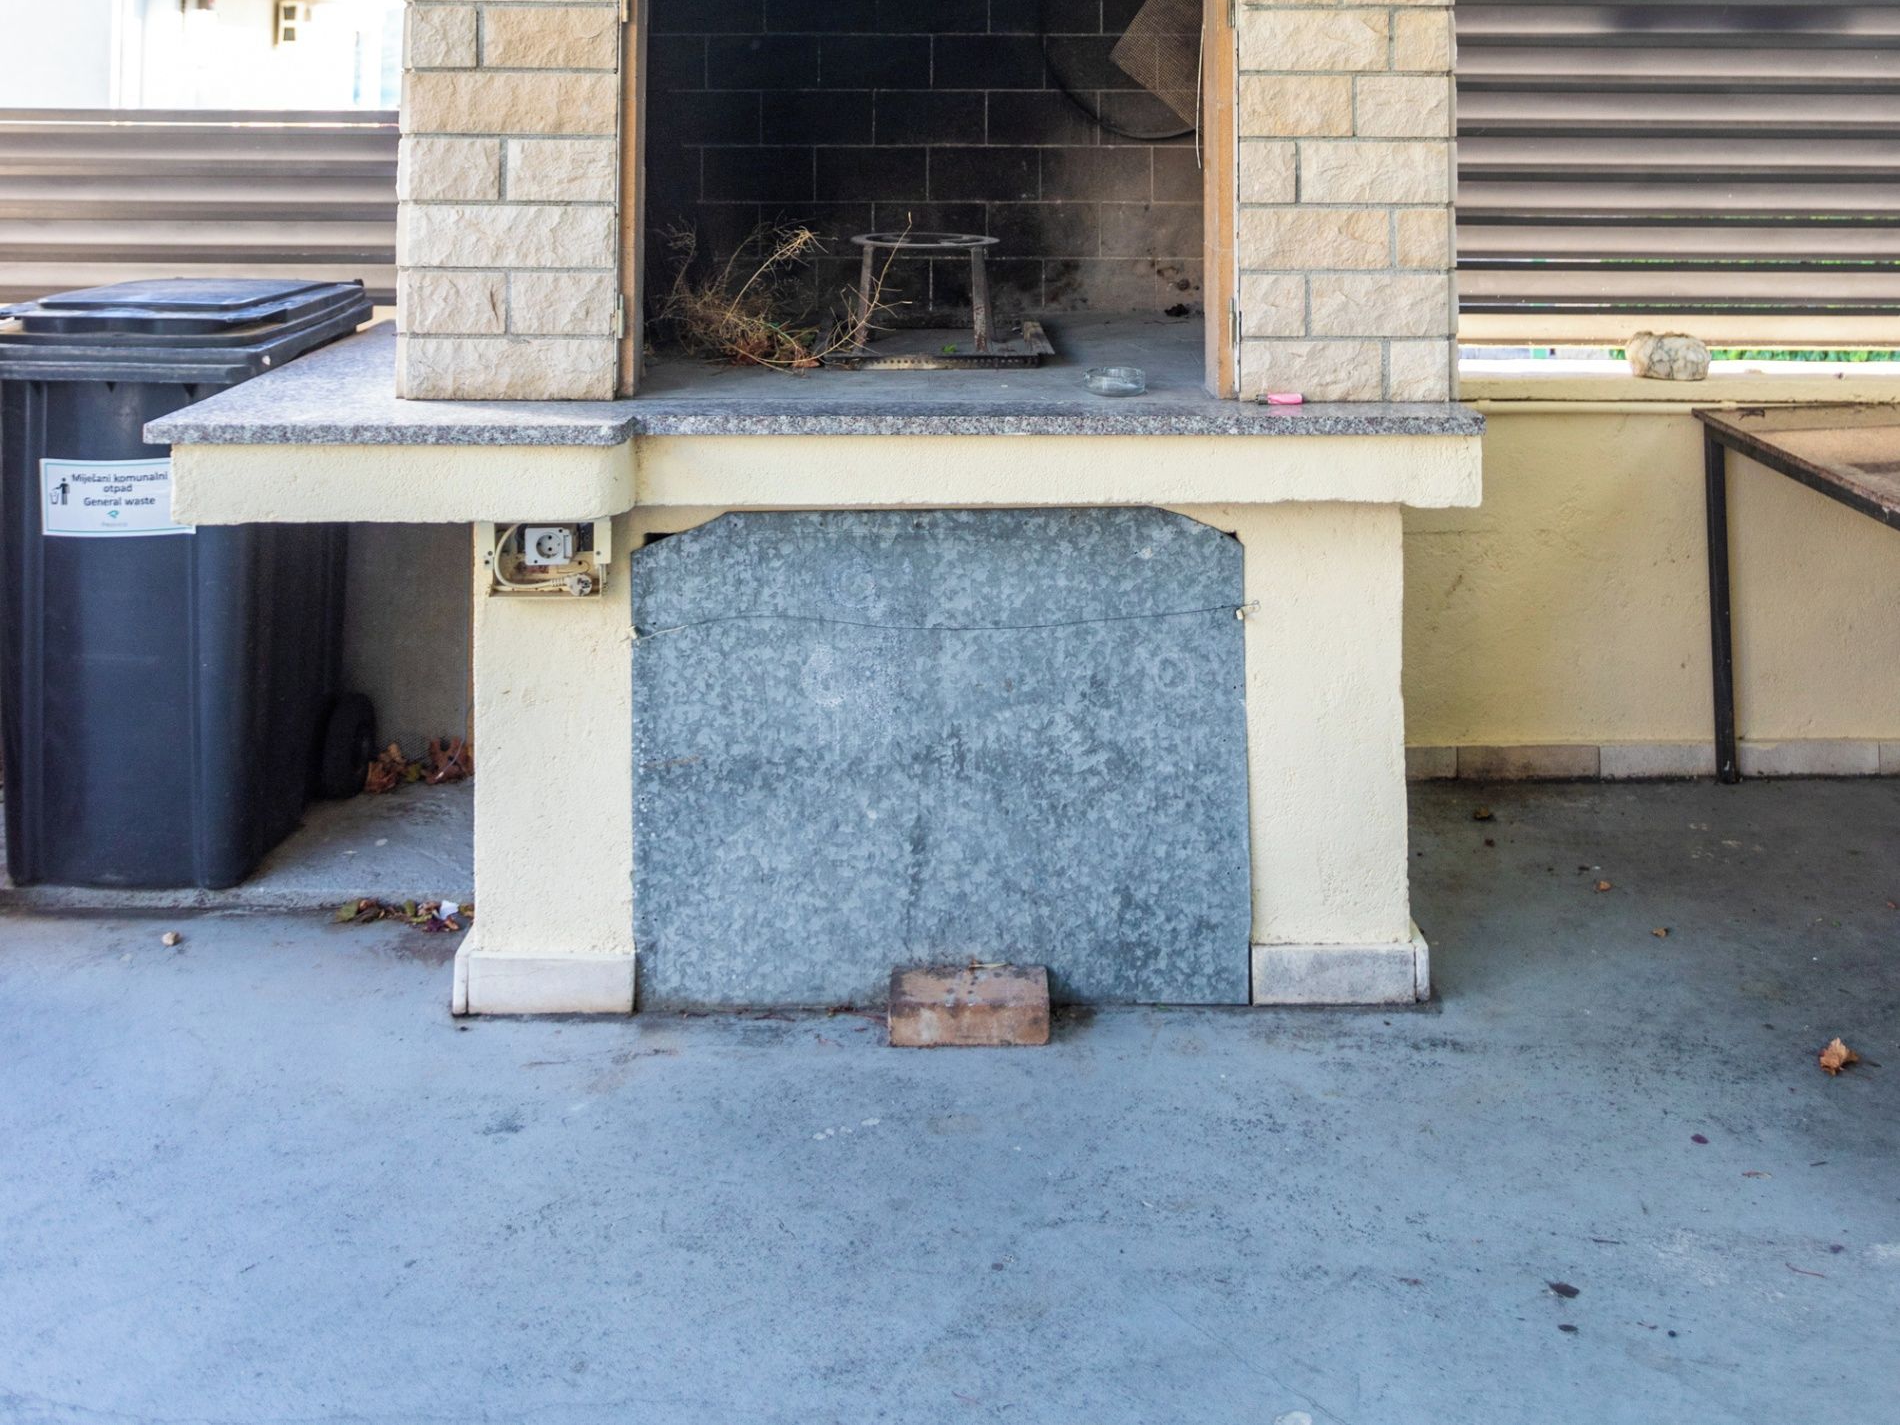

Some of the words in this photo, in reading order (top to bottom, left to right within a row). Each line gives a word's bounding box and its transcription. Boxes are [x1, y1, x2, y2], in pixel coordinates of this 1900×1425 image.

[113, 471, 168, 482] komunalni
[103, 484, 133, 493] otpad
[84, 496, 122, 506] General
[125, 497, 156, 506] waste
